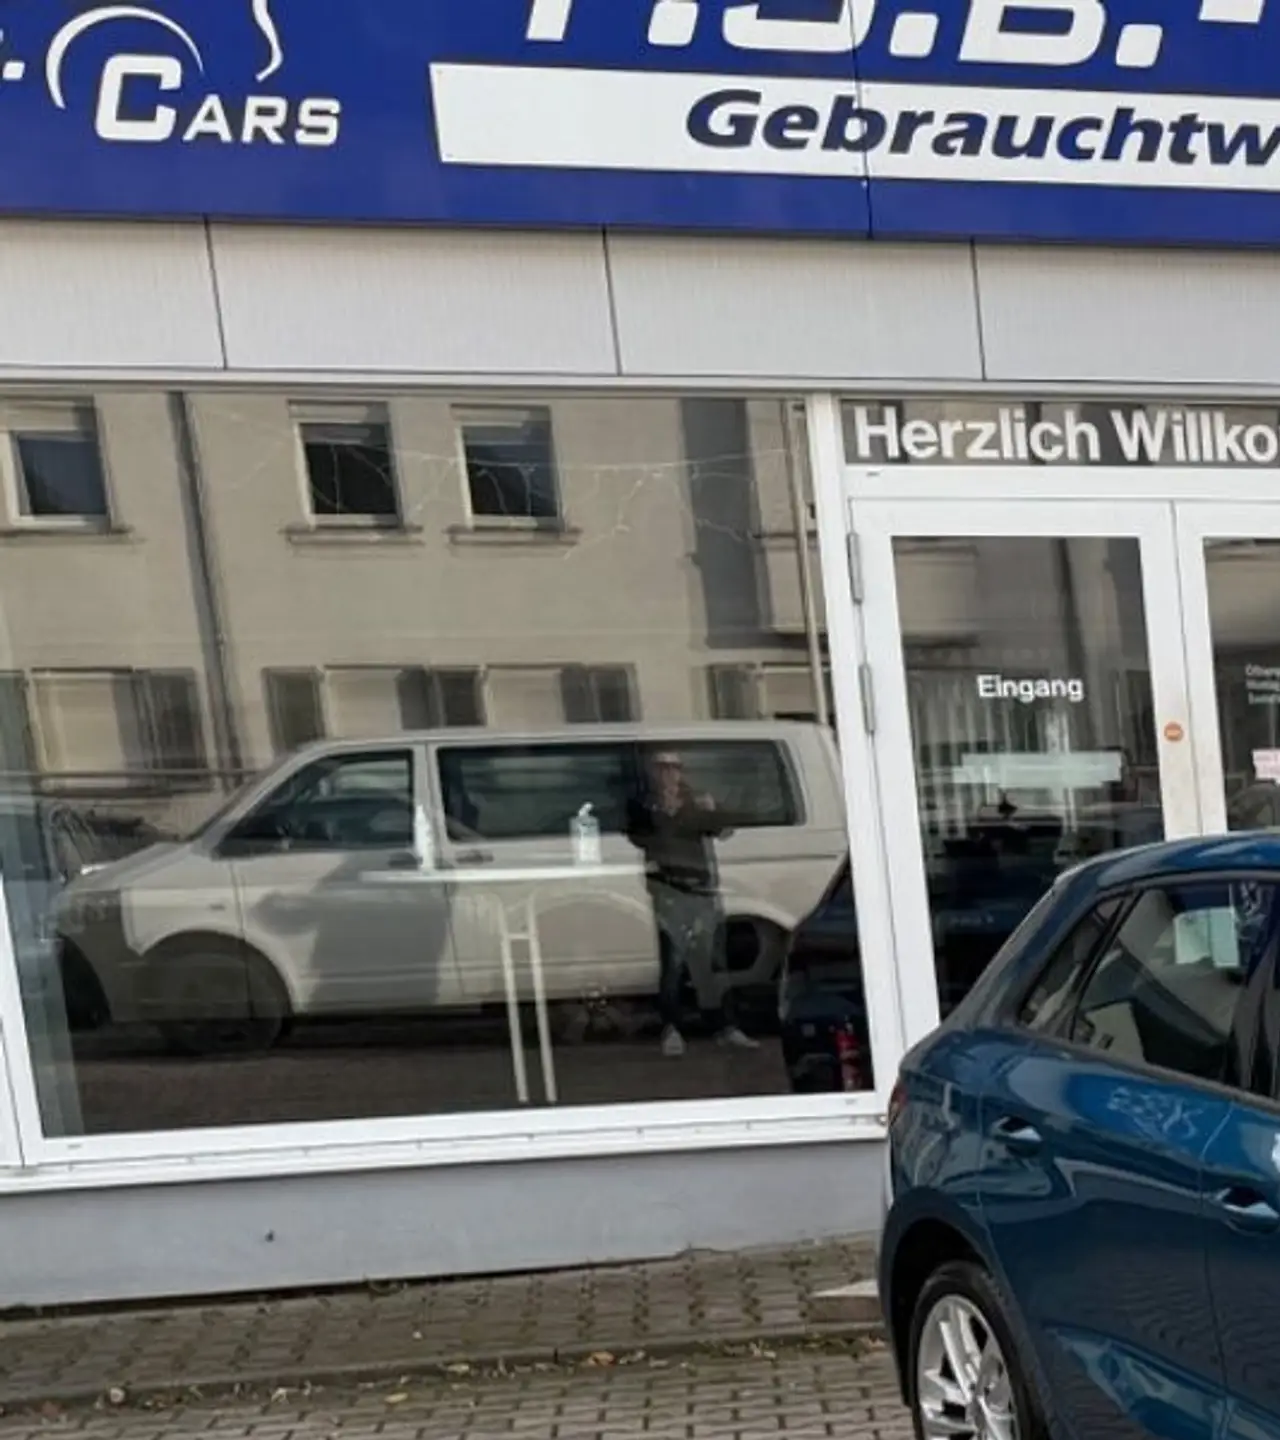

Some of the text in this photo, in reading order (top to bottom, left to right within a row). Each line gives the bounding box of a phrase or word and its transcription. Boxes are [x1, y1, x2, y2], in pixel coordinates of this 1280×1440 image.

[95, 54, 341, 146] CARS
[854, 405, 1101, 461] Herzlich
[976, 674, 1085, 703] Eingang
